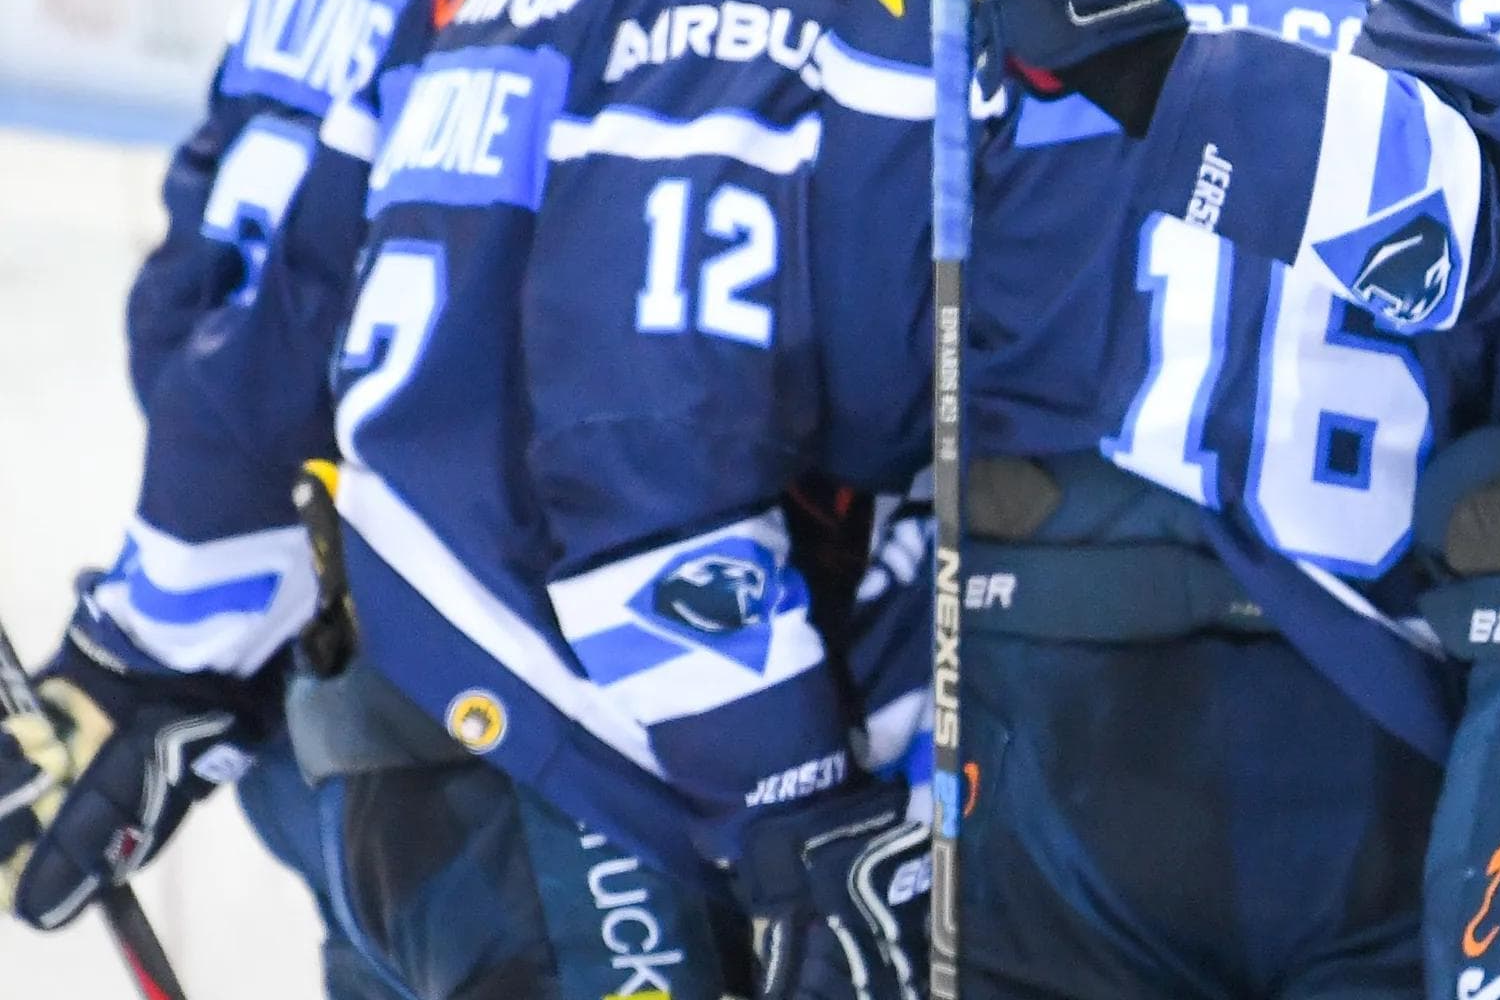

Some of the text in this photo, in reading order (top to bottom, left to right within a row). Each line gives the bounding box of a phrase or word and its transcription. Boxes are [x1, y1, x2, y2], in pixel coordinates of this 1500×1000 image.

[637, 178, 777, 348] 12
[1098, 209, 1435, 583] 16
[934, 547, 960, 749] NEXUS
